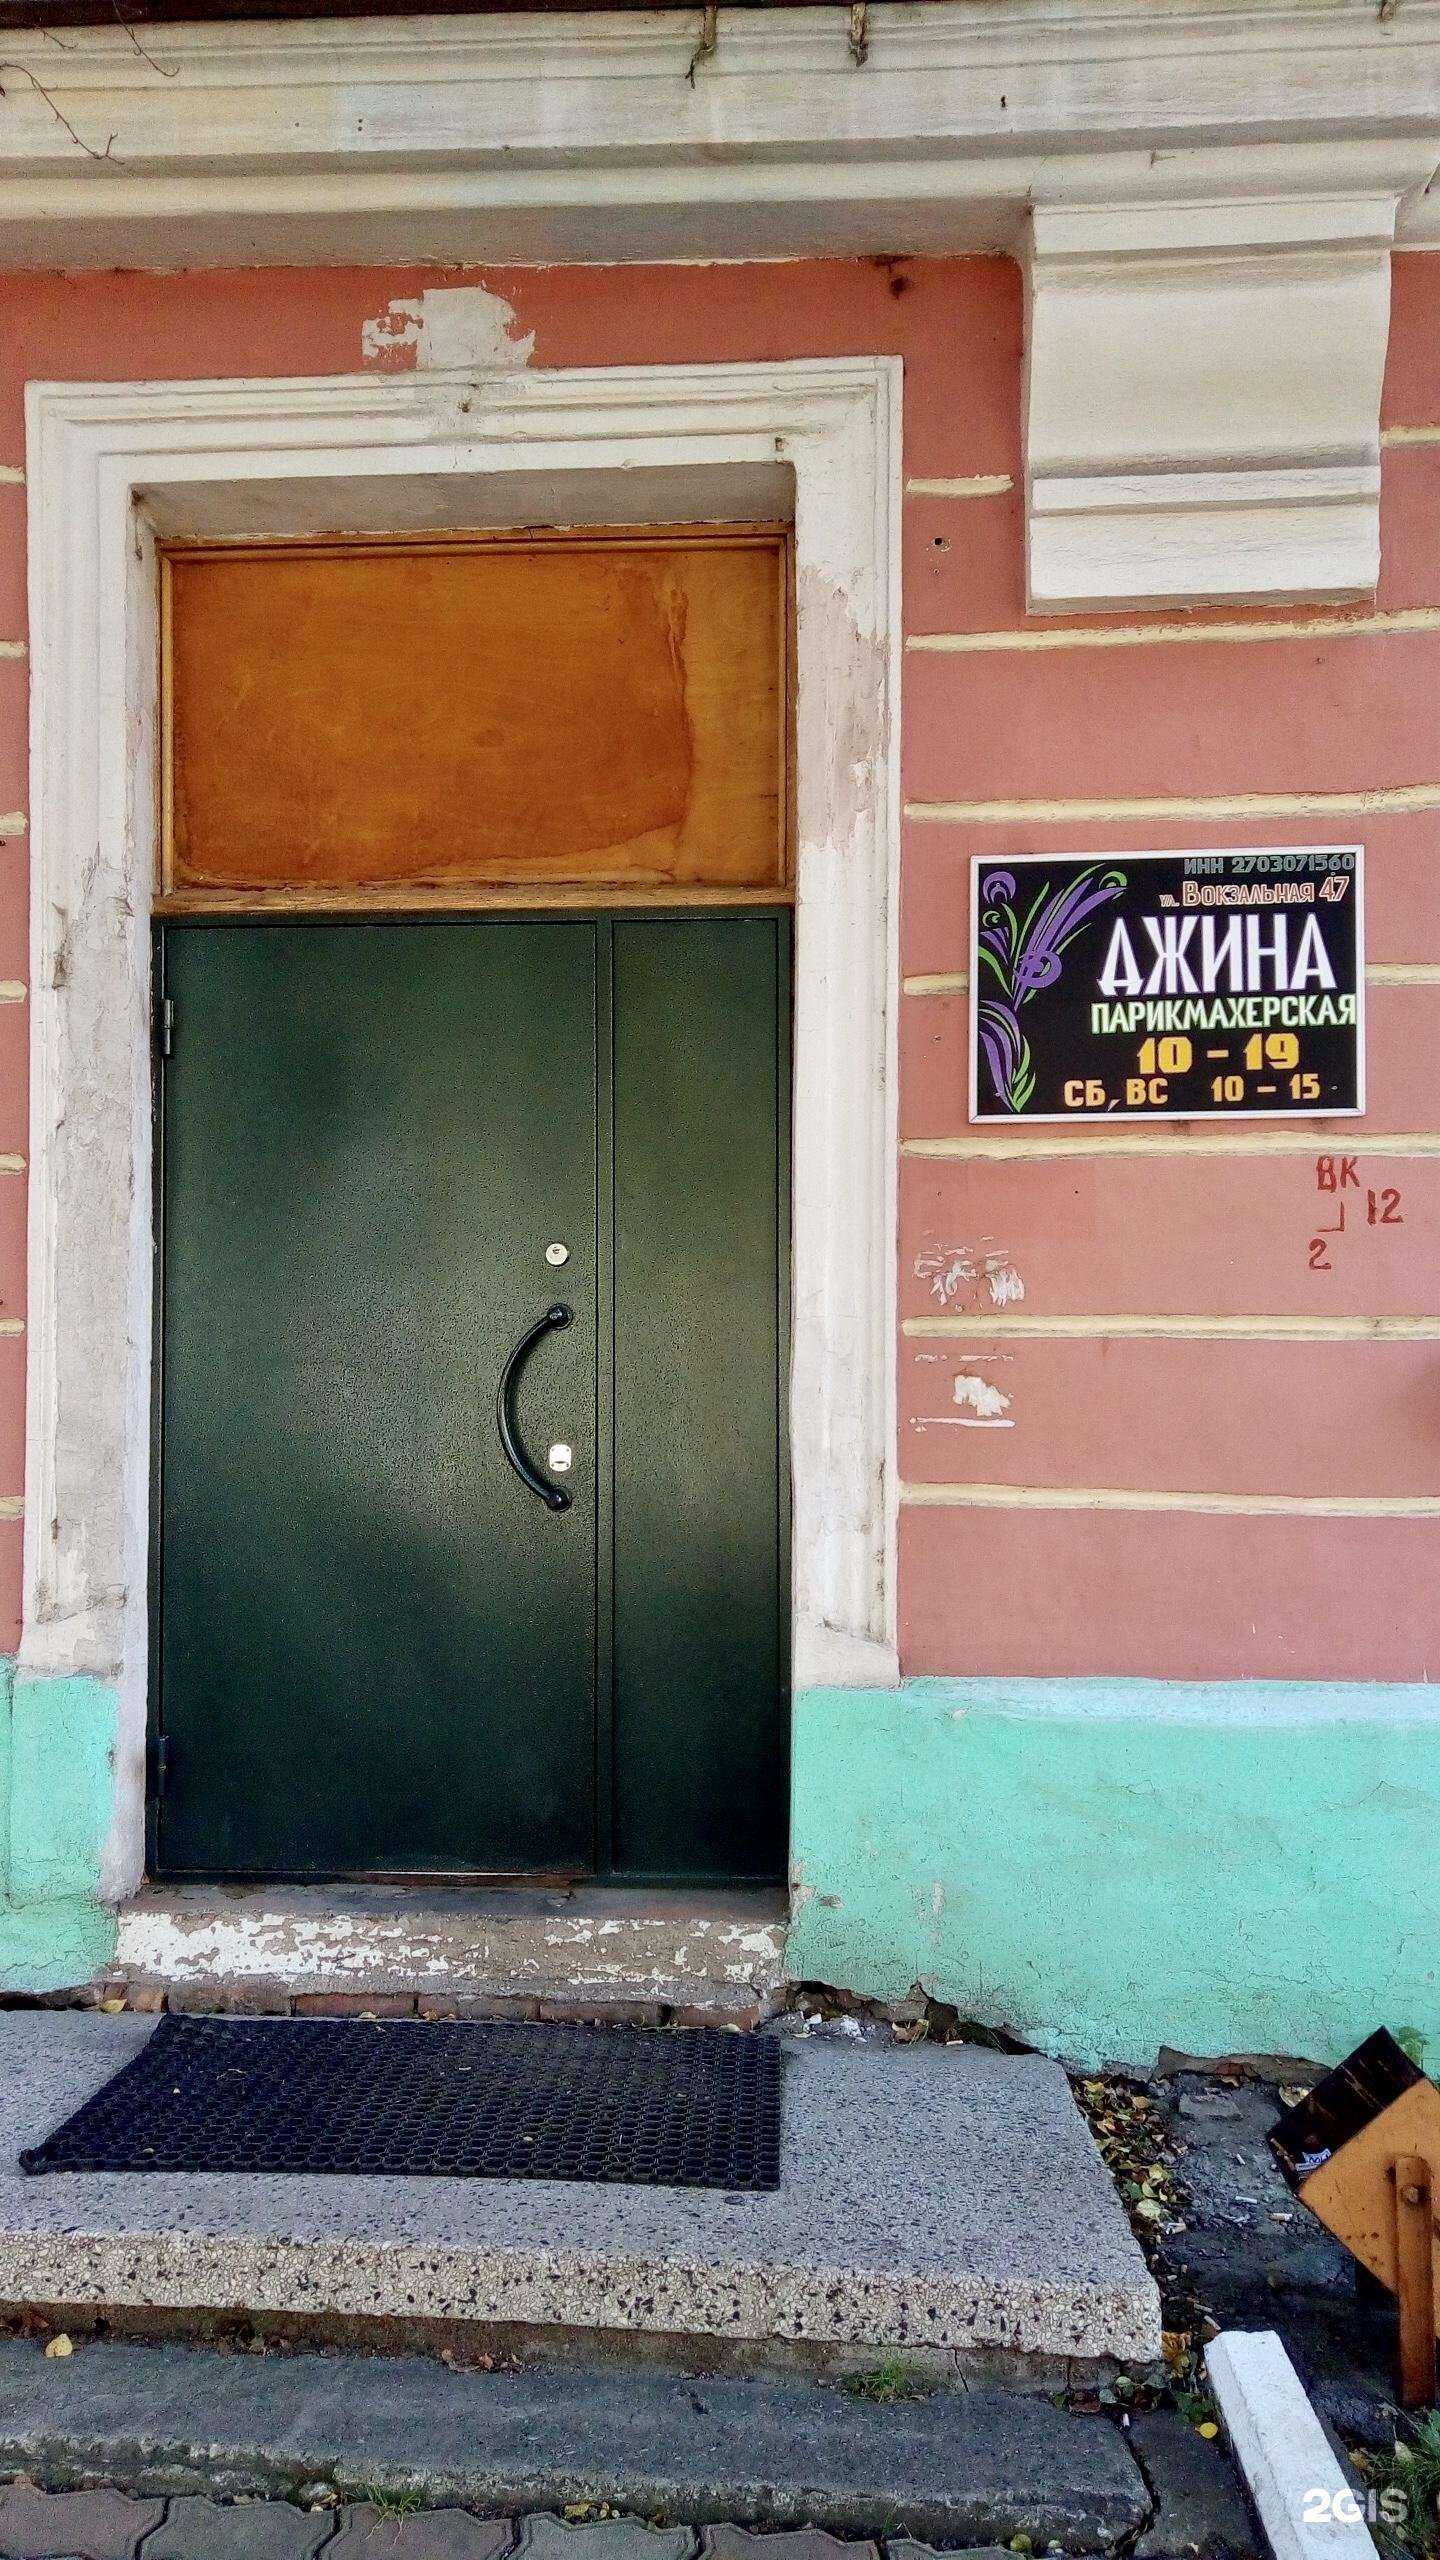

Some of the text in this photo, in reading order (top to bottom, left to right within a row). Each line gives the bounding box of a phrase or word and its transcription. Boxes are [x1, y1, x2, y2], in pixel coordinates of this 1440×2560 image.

[1184, 854, 1355, 875] ИНН 2703071560
[1319, 875, 1350, 902] 47
[1097, 912, 1338, 998] ДЖИНА
[1090, 993, 1357, 1035] ПАРИКМАХЕРСКАЯ
[1136, 1036, 1193, 1075] 10
[1243, 1033, 1300, 1071] 19
[1210, 1075, 1245, 1102] 10
[1289, 1073, 1321, 1100] 15
[1308, 1238, 1332, 1270] 2
